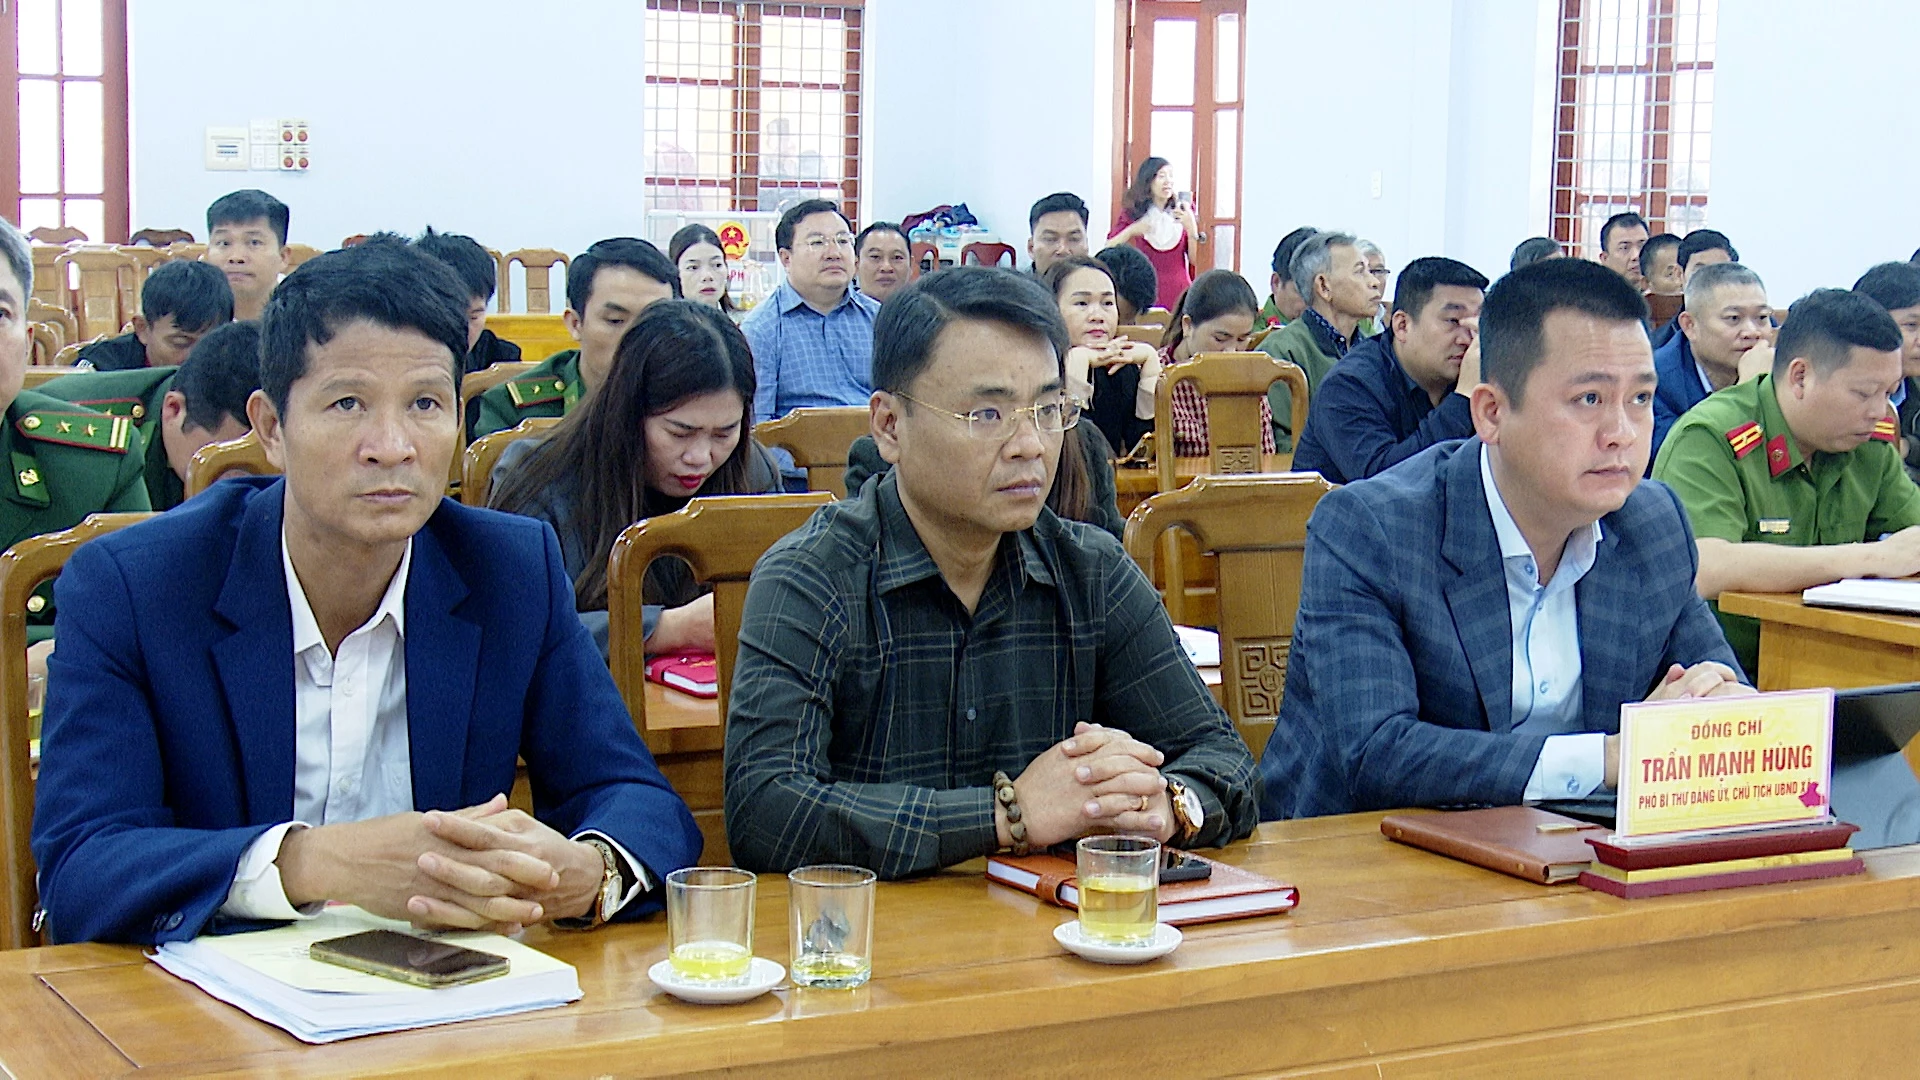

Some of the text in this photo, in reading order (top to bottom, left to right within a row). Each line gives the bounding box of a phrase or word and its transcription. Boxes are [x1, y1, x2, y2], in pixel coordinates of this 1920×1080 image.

[1738, 715, 1763, 736] CHÍ
[1642, 741, 1812, 783] TRẦN MẠNH HÙNG
[1639, 791, 1657, 809] PHÓ
[1671, 791, 1689, 806] THƯ
[1733, 781, 1751, 800] CHỦ
[1753, 783, 1772, 801] TỊCH
[1775, 781, 1798, 796] UBND
